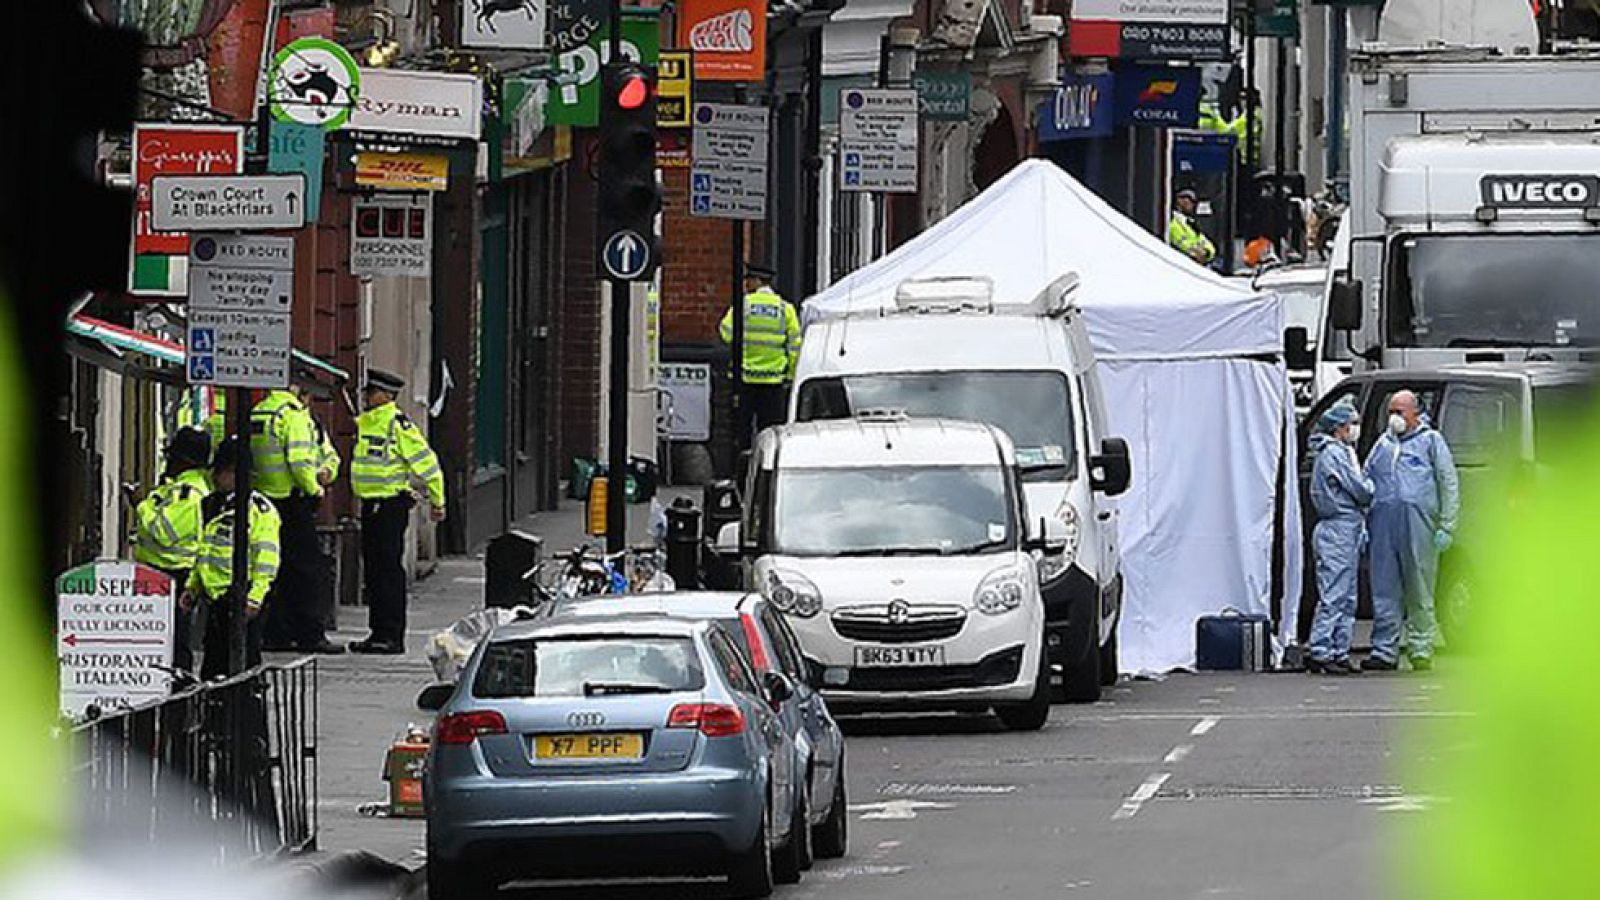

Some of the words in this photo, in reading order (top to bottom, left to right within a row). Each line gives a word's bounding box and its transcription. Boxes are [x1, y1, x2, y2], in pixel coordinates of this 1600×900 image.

[354, 97, 462, 117] Ryman
[866, 97, 884, 105] RED
[885, 97, 914, 106] ROUTE
[1133, 109, 1179, 120] CORAL
[170, 187, 218, 202] Crown
[223, 187, 265, 202] Court
[1493, 182, 1588, 202] IVECO
[171, 203, 189, 217] At
[194, 202, 275, 217] Blackfriars
[358, 210, 424, 236] CUE
[221, 244, 246, 257] RED
[249, 245, 289, 259] ROUTE
[354, 242, 425, 257] PERSONNEL
[208, 270, 223, 279] No
[226, 271, 275, 286] stopping
[211, 284, 224, 293] on
[227, 284, 248, 295] any
[250, 284, 270, 297] day
[190, 312, 228, 326] Except
[242, 347, 259, 358] 20
[676, 367, 707, 380] LTD
[73, 603, 100, 614] OUR
[104, 603, 155, 615] CELLAR
[62, 619, 101, 632] FULLY
[103, 619, 166, 632] LICENSED
[61, 654, 165, 669] RISTORANTE
[75, 671, 152, 687] ITALIANO
[550, 737, 575, 754] X7
[588, 738, 624, 754] PPF
